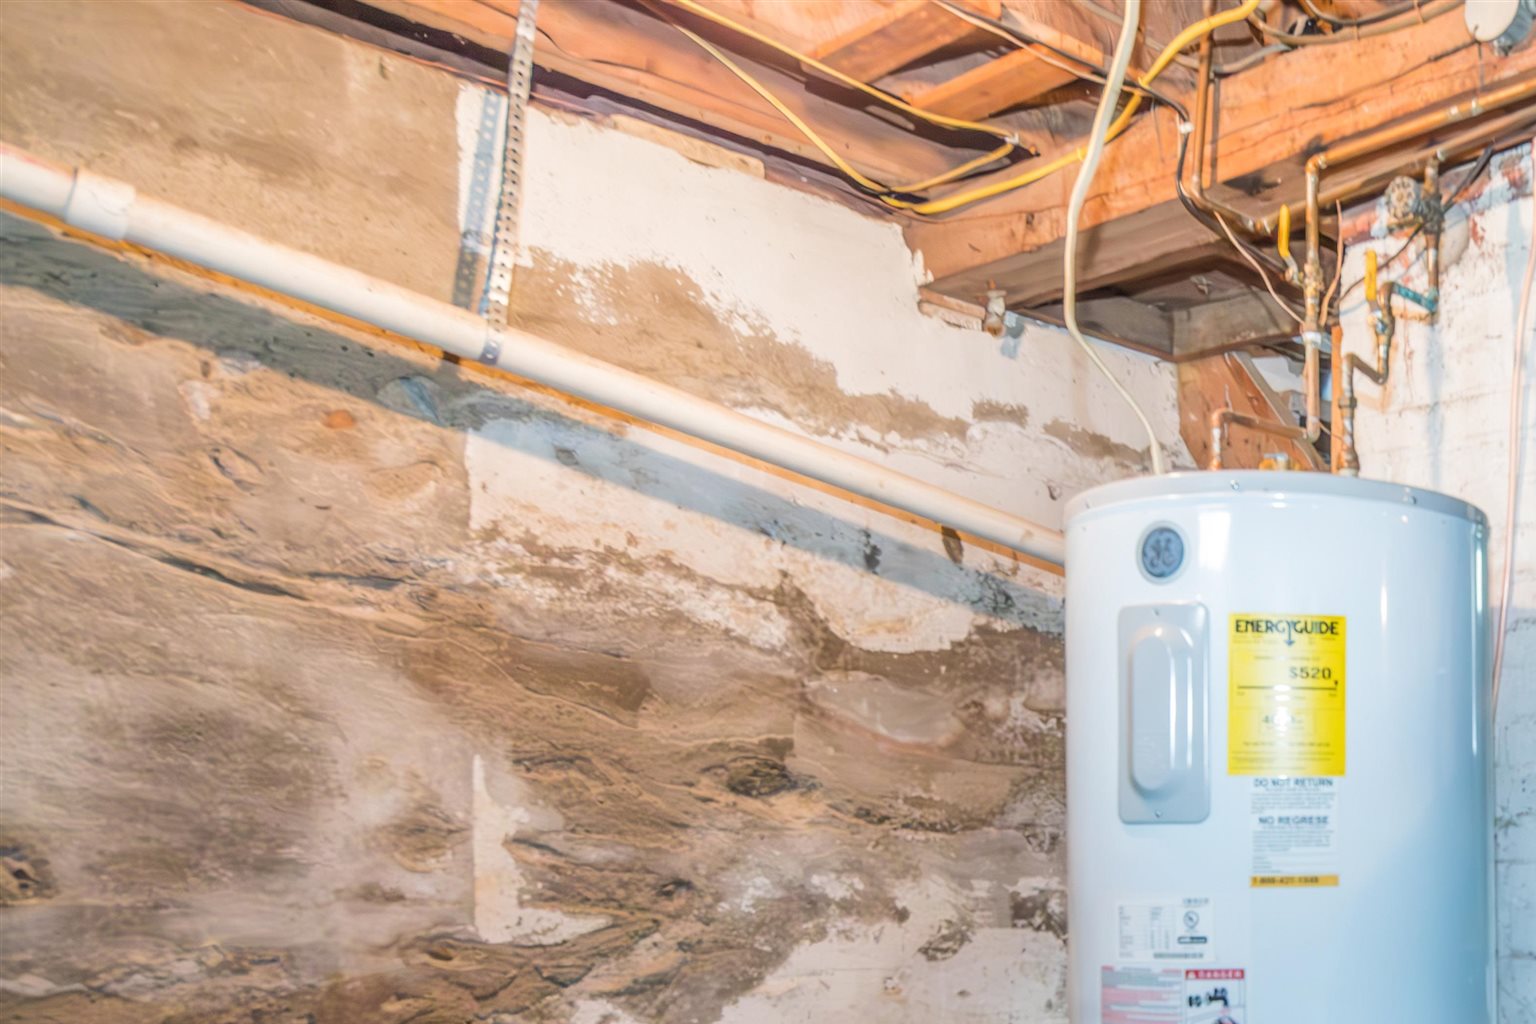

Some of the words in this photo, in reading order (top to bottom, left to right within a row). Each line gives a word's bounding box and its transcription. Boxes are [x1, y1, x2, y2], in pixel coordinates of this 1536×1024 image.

[1289, 666, 1332, 679] $520
[1254, 779, 1268, 787] DO
[1271, 778, 1290, 786] NOT
[1294, 778, 1334, 786] RETURN
[1259, 816, 1274, 824] NO
